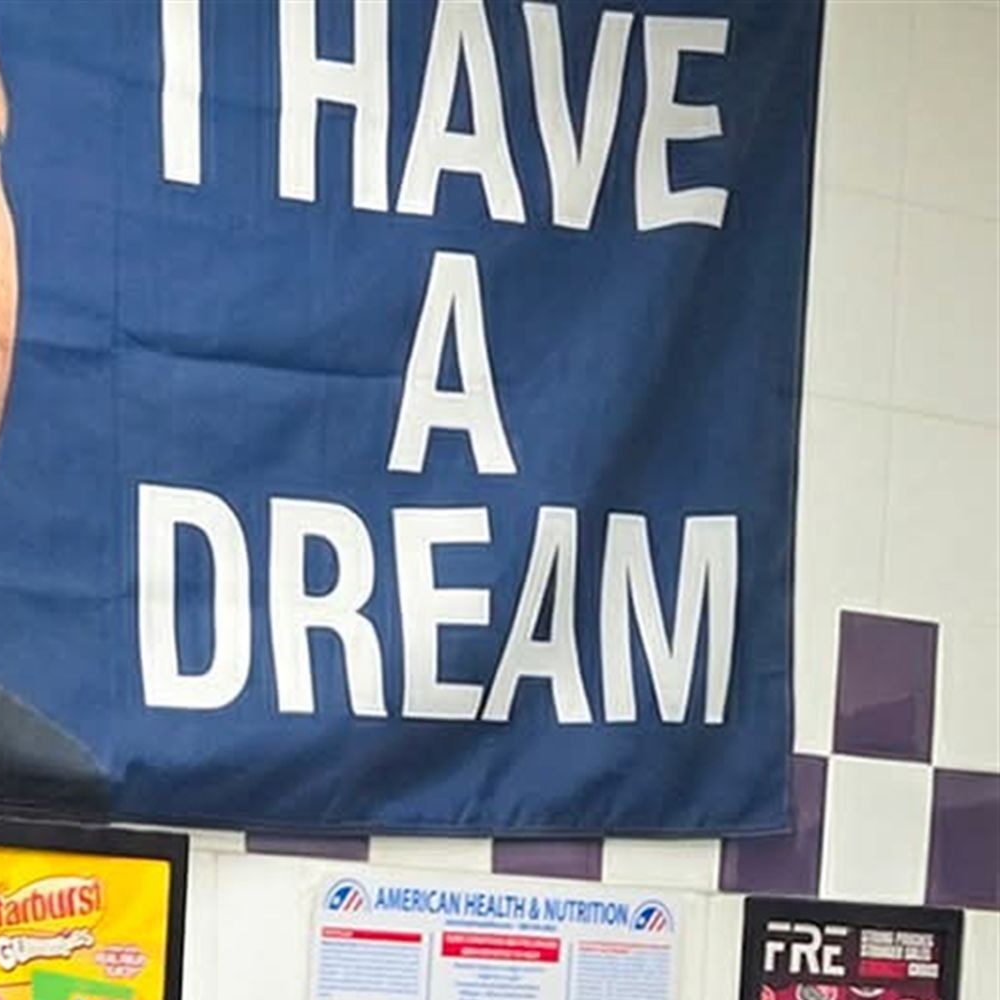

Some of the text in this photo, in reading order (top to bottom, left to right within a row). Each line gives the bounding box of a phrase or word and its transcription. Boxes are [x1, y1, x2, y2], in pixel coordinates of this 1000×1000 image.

[162, 0, 730, 231] I HAVE
[387, 251, 518, 475] A
[138, 483, 739, 725] DREAM
[374, 887, 629, 924] AMERICAN HEALTH & NUTRITION
[763, 921, 849, 977] FRE
